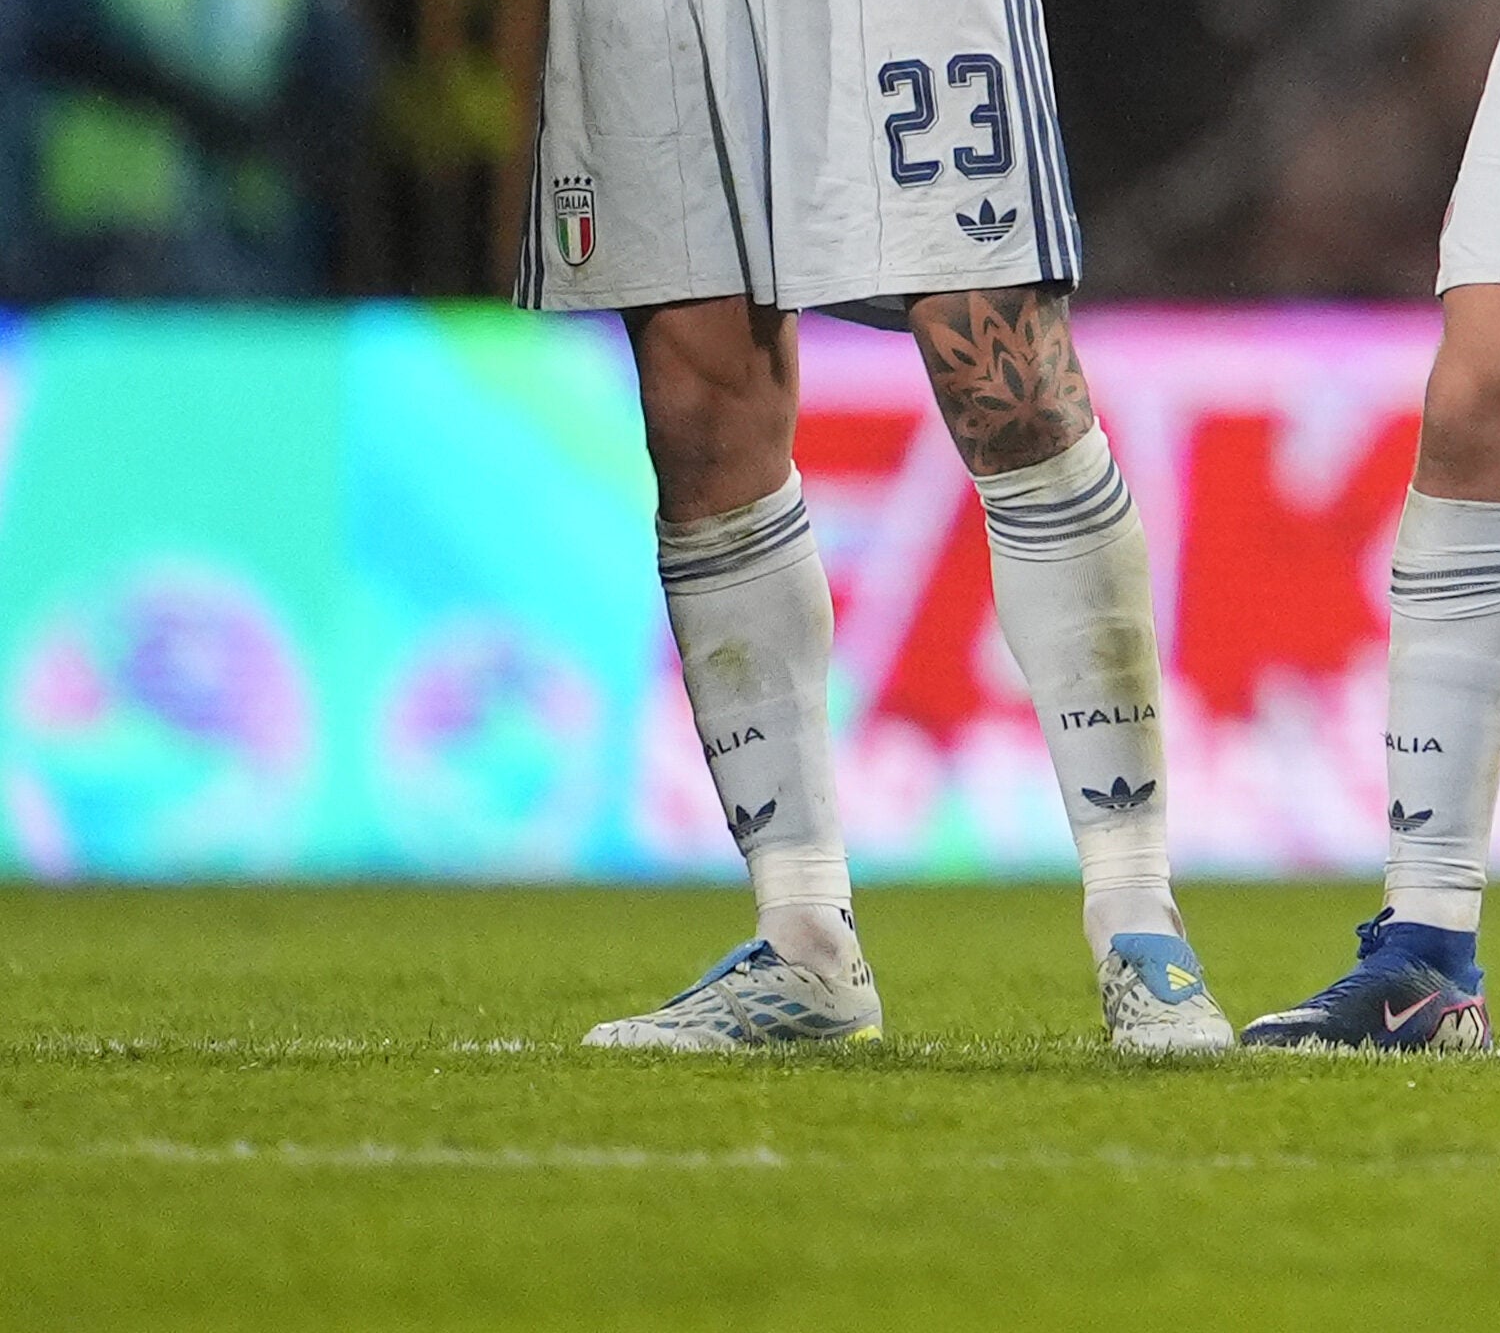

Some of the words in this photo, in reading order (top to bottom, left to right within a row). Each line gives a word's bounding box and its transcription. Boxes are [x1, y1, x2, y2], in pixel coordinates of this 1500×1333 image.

[878, 53, 1016, 188] 23
[557, 195, 589, 210] ITALIA
[1060, 703, 1155, 731] ITALIA
[704, 727, 766, 764] ALIA
[1385, 733, 1444, 753] ALIA
